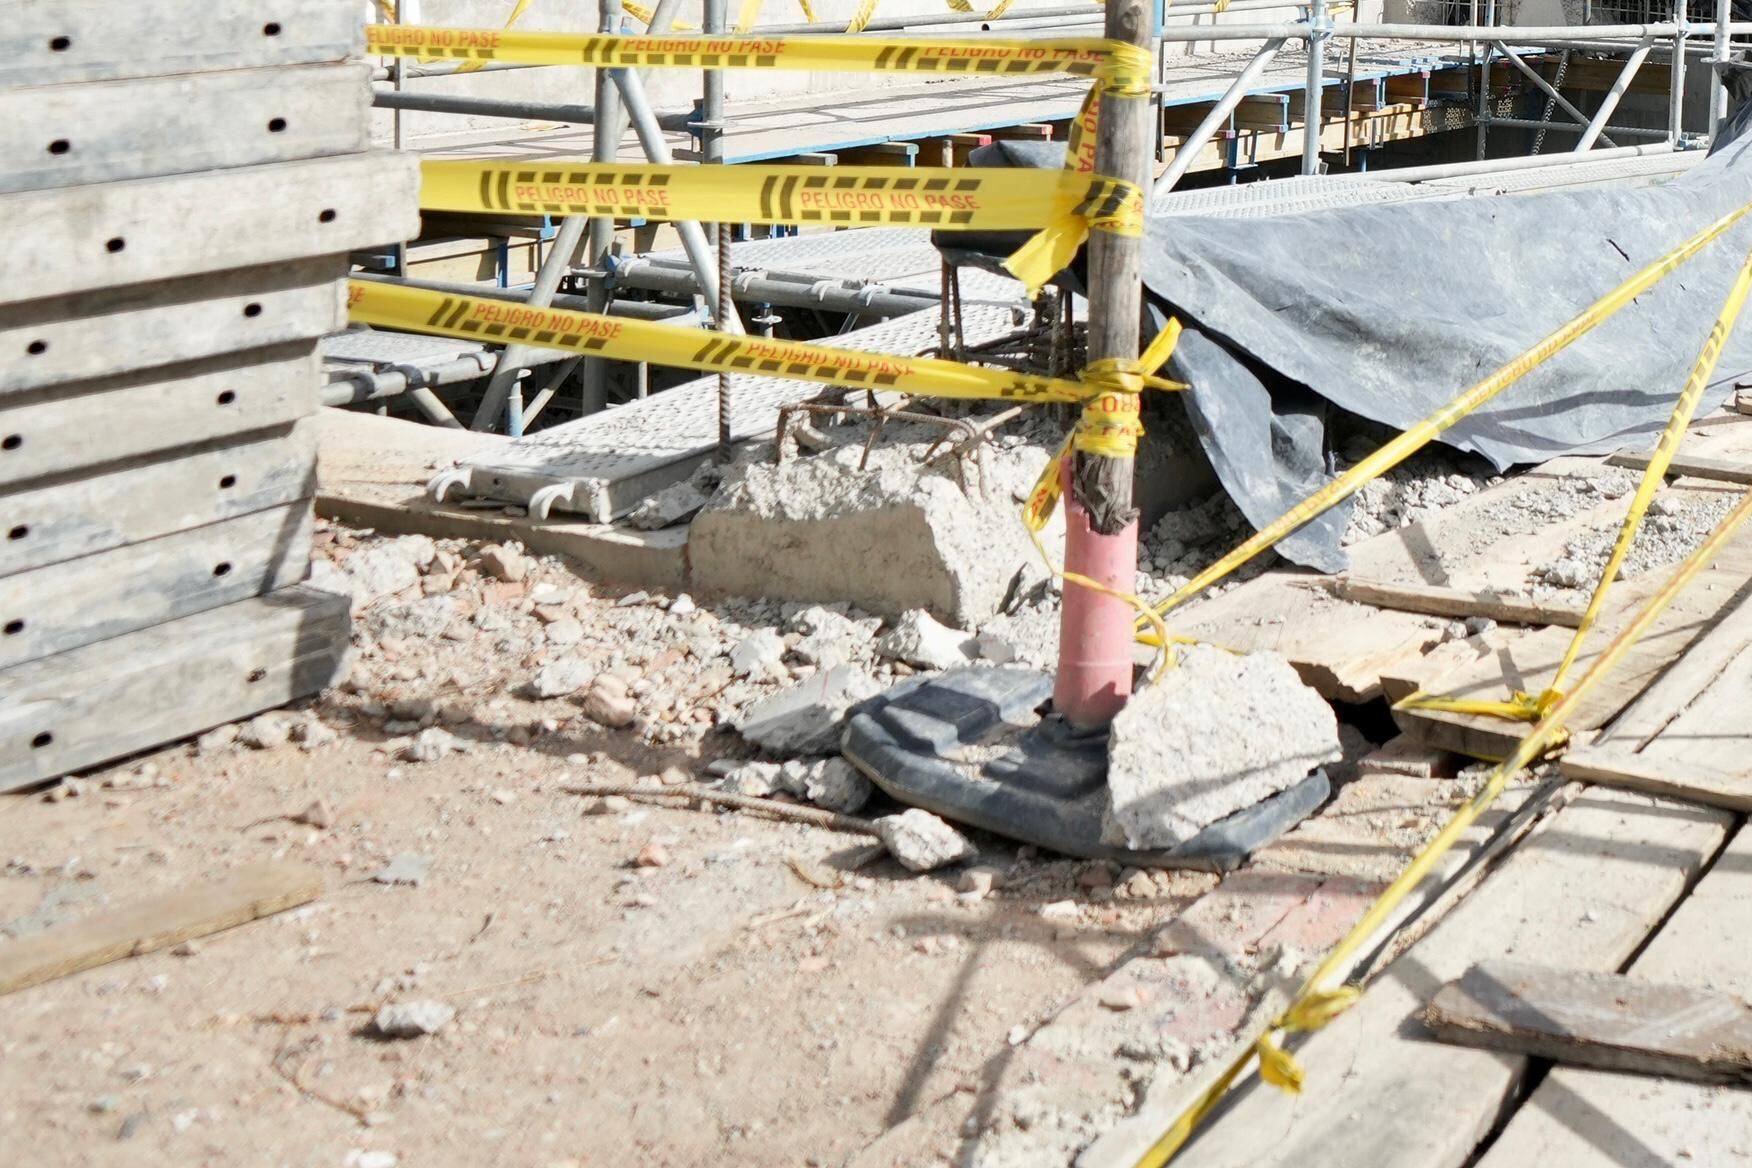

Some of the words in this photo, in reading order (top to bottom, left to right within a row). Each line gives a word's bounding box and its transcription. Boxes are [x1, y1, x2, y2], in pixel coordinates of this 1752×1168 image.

[367, 28, 424, 46] ELIGRO
[430, 30, 453, 47] NO
[458, 32, 501, 49] PASE
[623, 38, 703, 53] PELIGRO
[707, 40, 732, 53] NO
[738, 40, 786, 55] PASE
[1052, 48, 1106, 62] PASE
[515, 186, 590, 204] PELIGRO
[594, 188, 618, 205] NO
[624, 189, 670, 206] PASE
[801, 191, 883, 209] PELIGRO
[890, 192, 920, 209] NO
[925, 194, 982, 210] PASE
[473, 304, 546, 332] PELIGRO
[550, 315, 573, 332] NO
[577, 320, 623, 339] PASE
[746, 343, 828, 366] PELIGRO
[834, 355, 862, 369] NO
[868, 359, 915, 377] PASE
